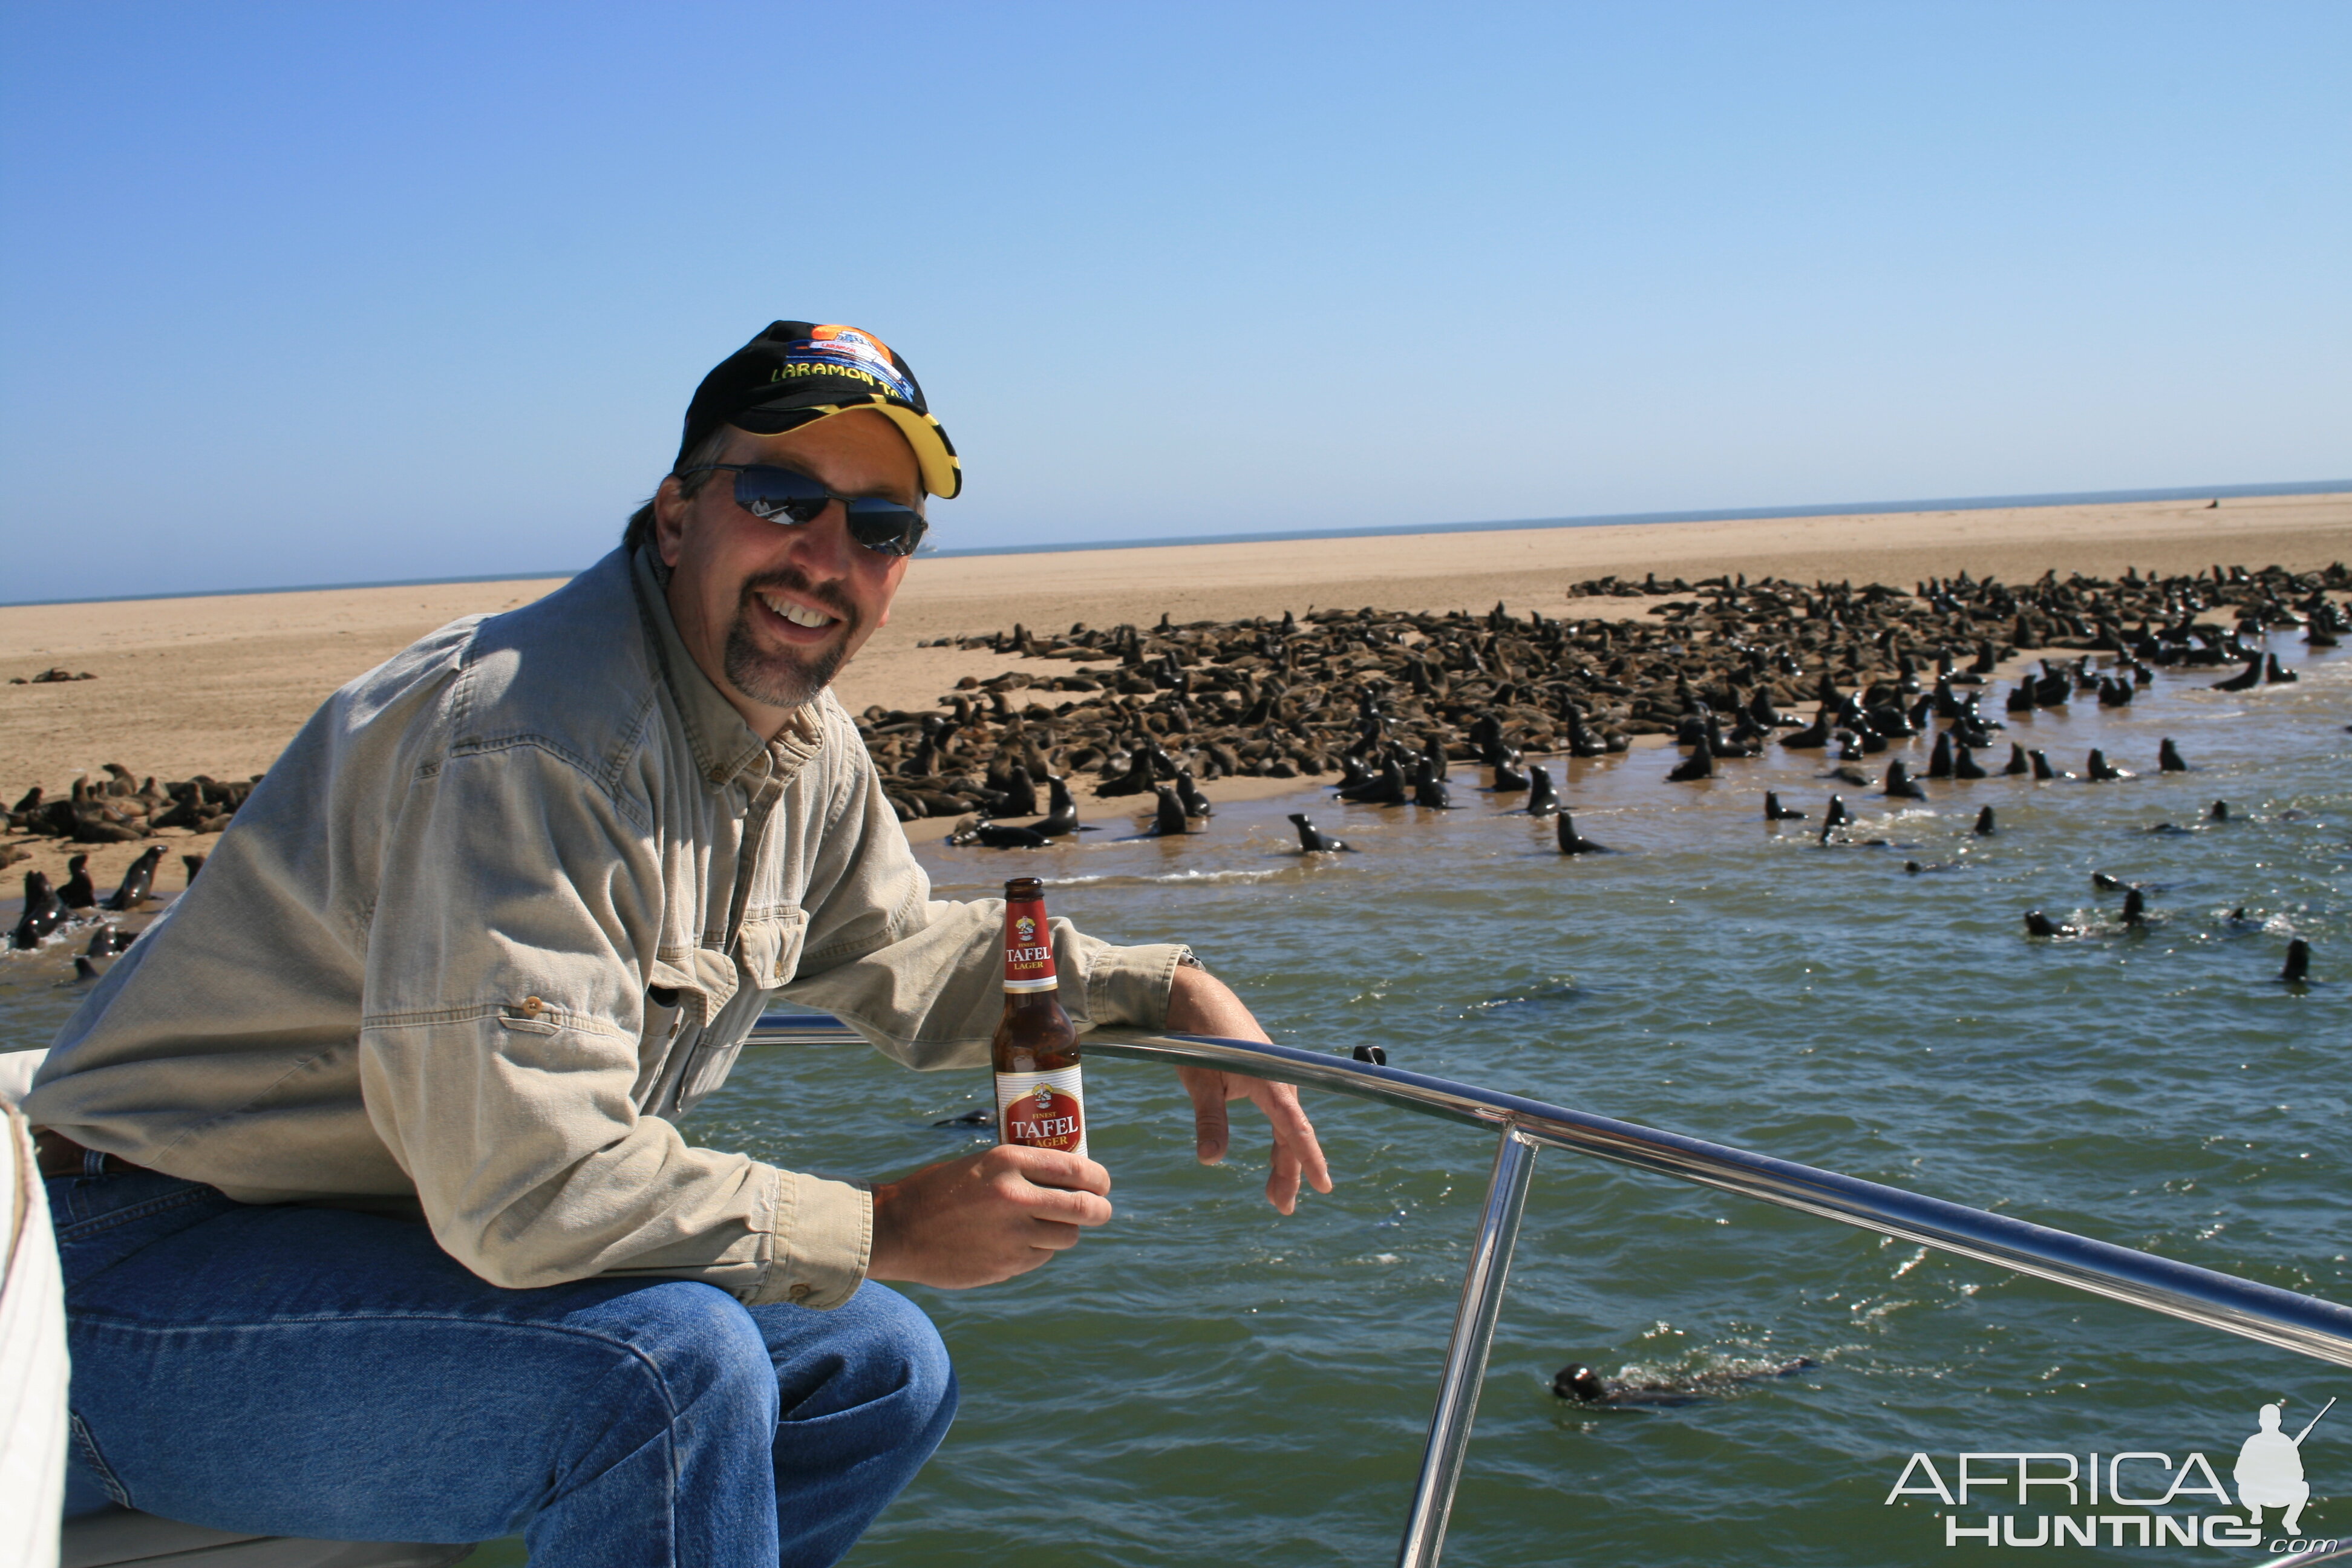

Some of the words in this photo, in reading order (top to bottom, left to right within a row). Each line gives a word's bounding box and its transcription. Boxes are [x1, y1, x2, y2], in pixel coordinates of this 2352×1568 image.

[771, 364, 874, 386] LARAMON
[1007, 947, 1050, 962] TAFEL
[1011, 1116, 1078, 1138] TAFEL
